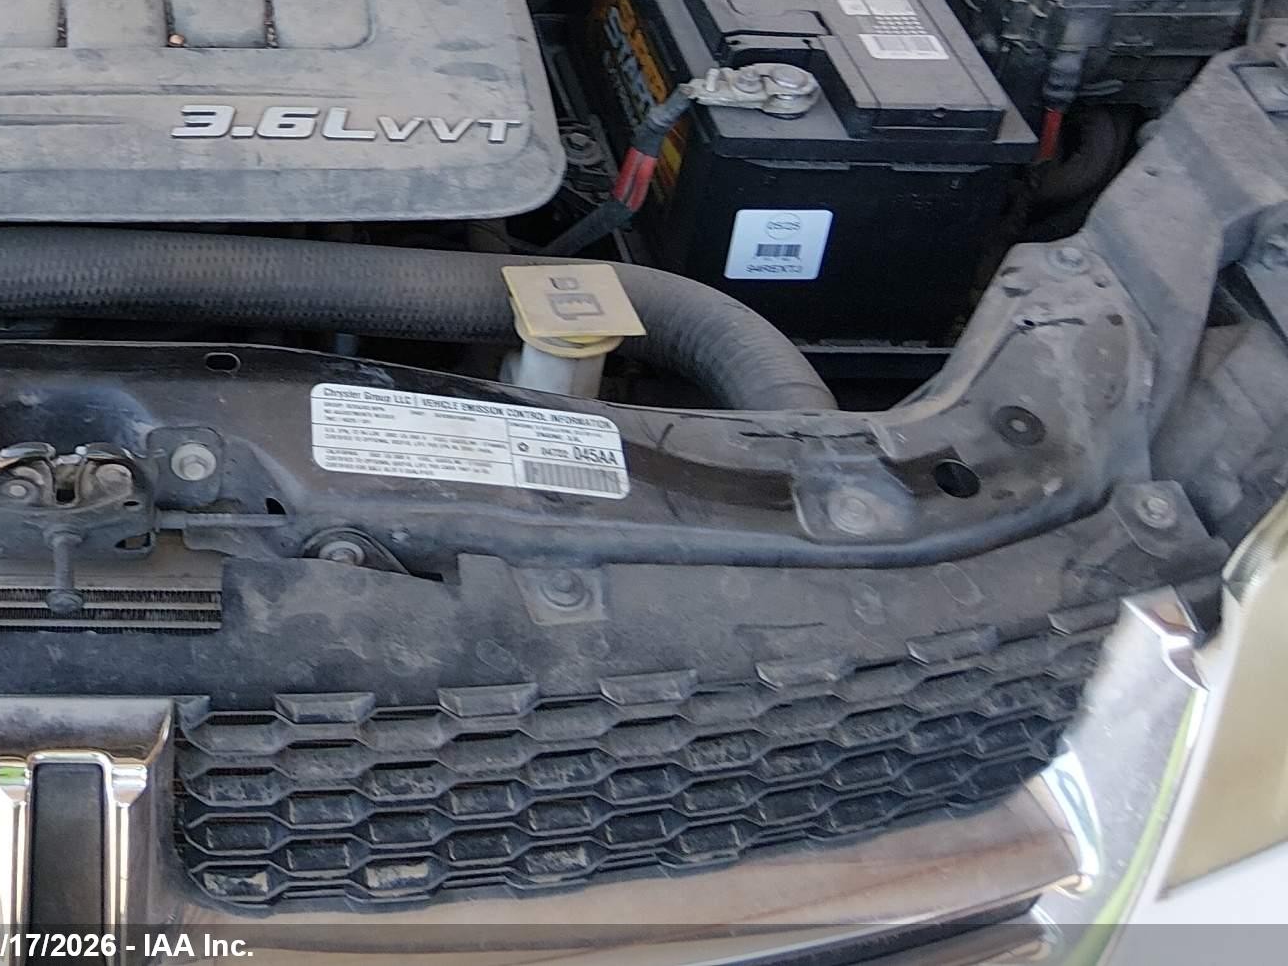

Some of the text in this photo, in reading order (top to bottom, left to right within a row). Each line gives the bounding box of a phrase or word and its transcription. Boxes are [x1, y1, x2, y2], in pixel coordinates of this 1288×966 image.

[323, 387, 361, 400] Chrysler
[393, 394, 411, 405] LLC
[421, 398, 458, 410] VEHICLE
[462, 402, 505, 416] EMISSION
[507, 408, 547, 422] CONTROL
[549, 413, 612, 429] INFORMATION
